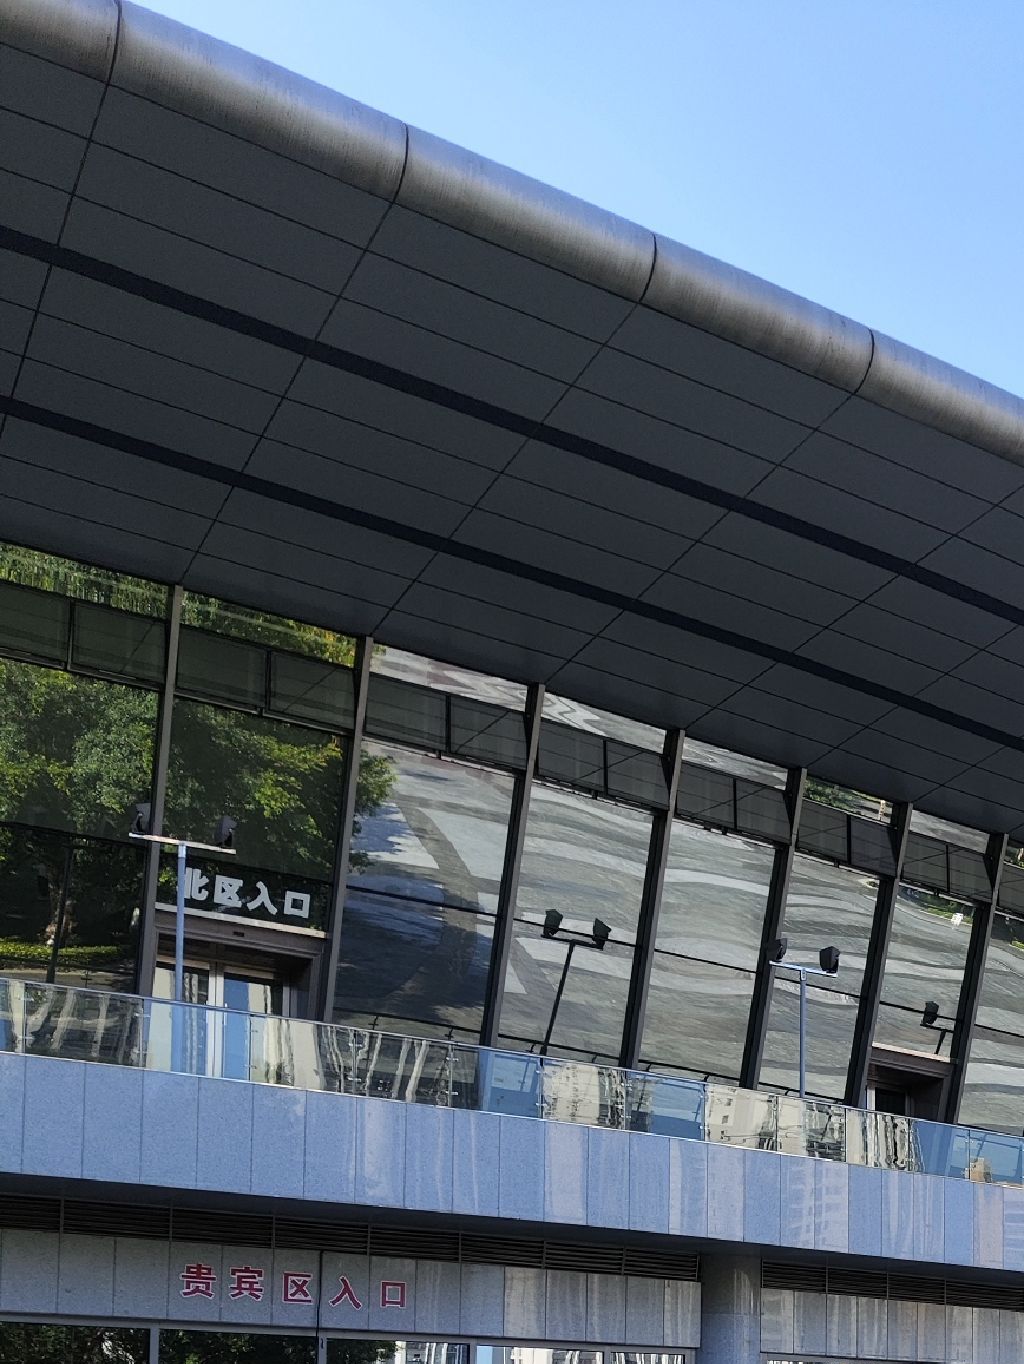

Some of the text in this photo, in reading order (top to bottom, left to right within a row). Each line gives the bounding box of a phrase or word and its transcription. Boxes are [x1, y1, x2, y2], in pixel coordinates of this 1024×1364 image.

[183, 866, 311, 919] 北区入口
[180, 1263, 408, 1310] 贵宾区入口
